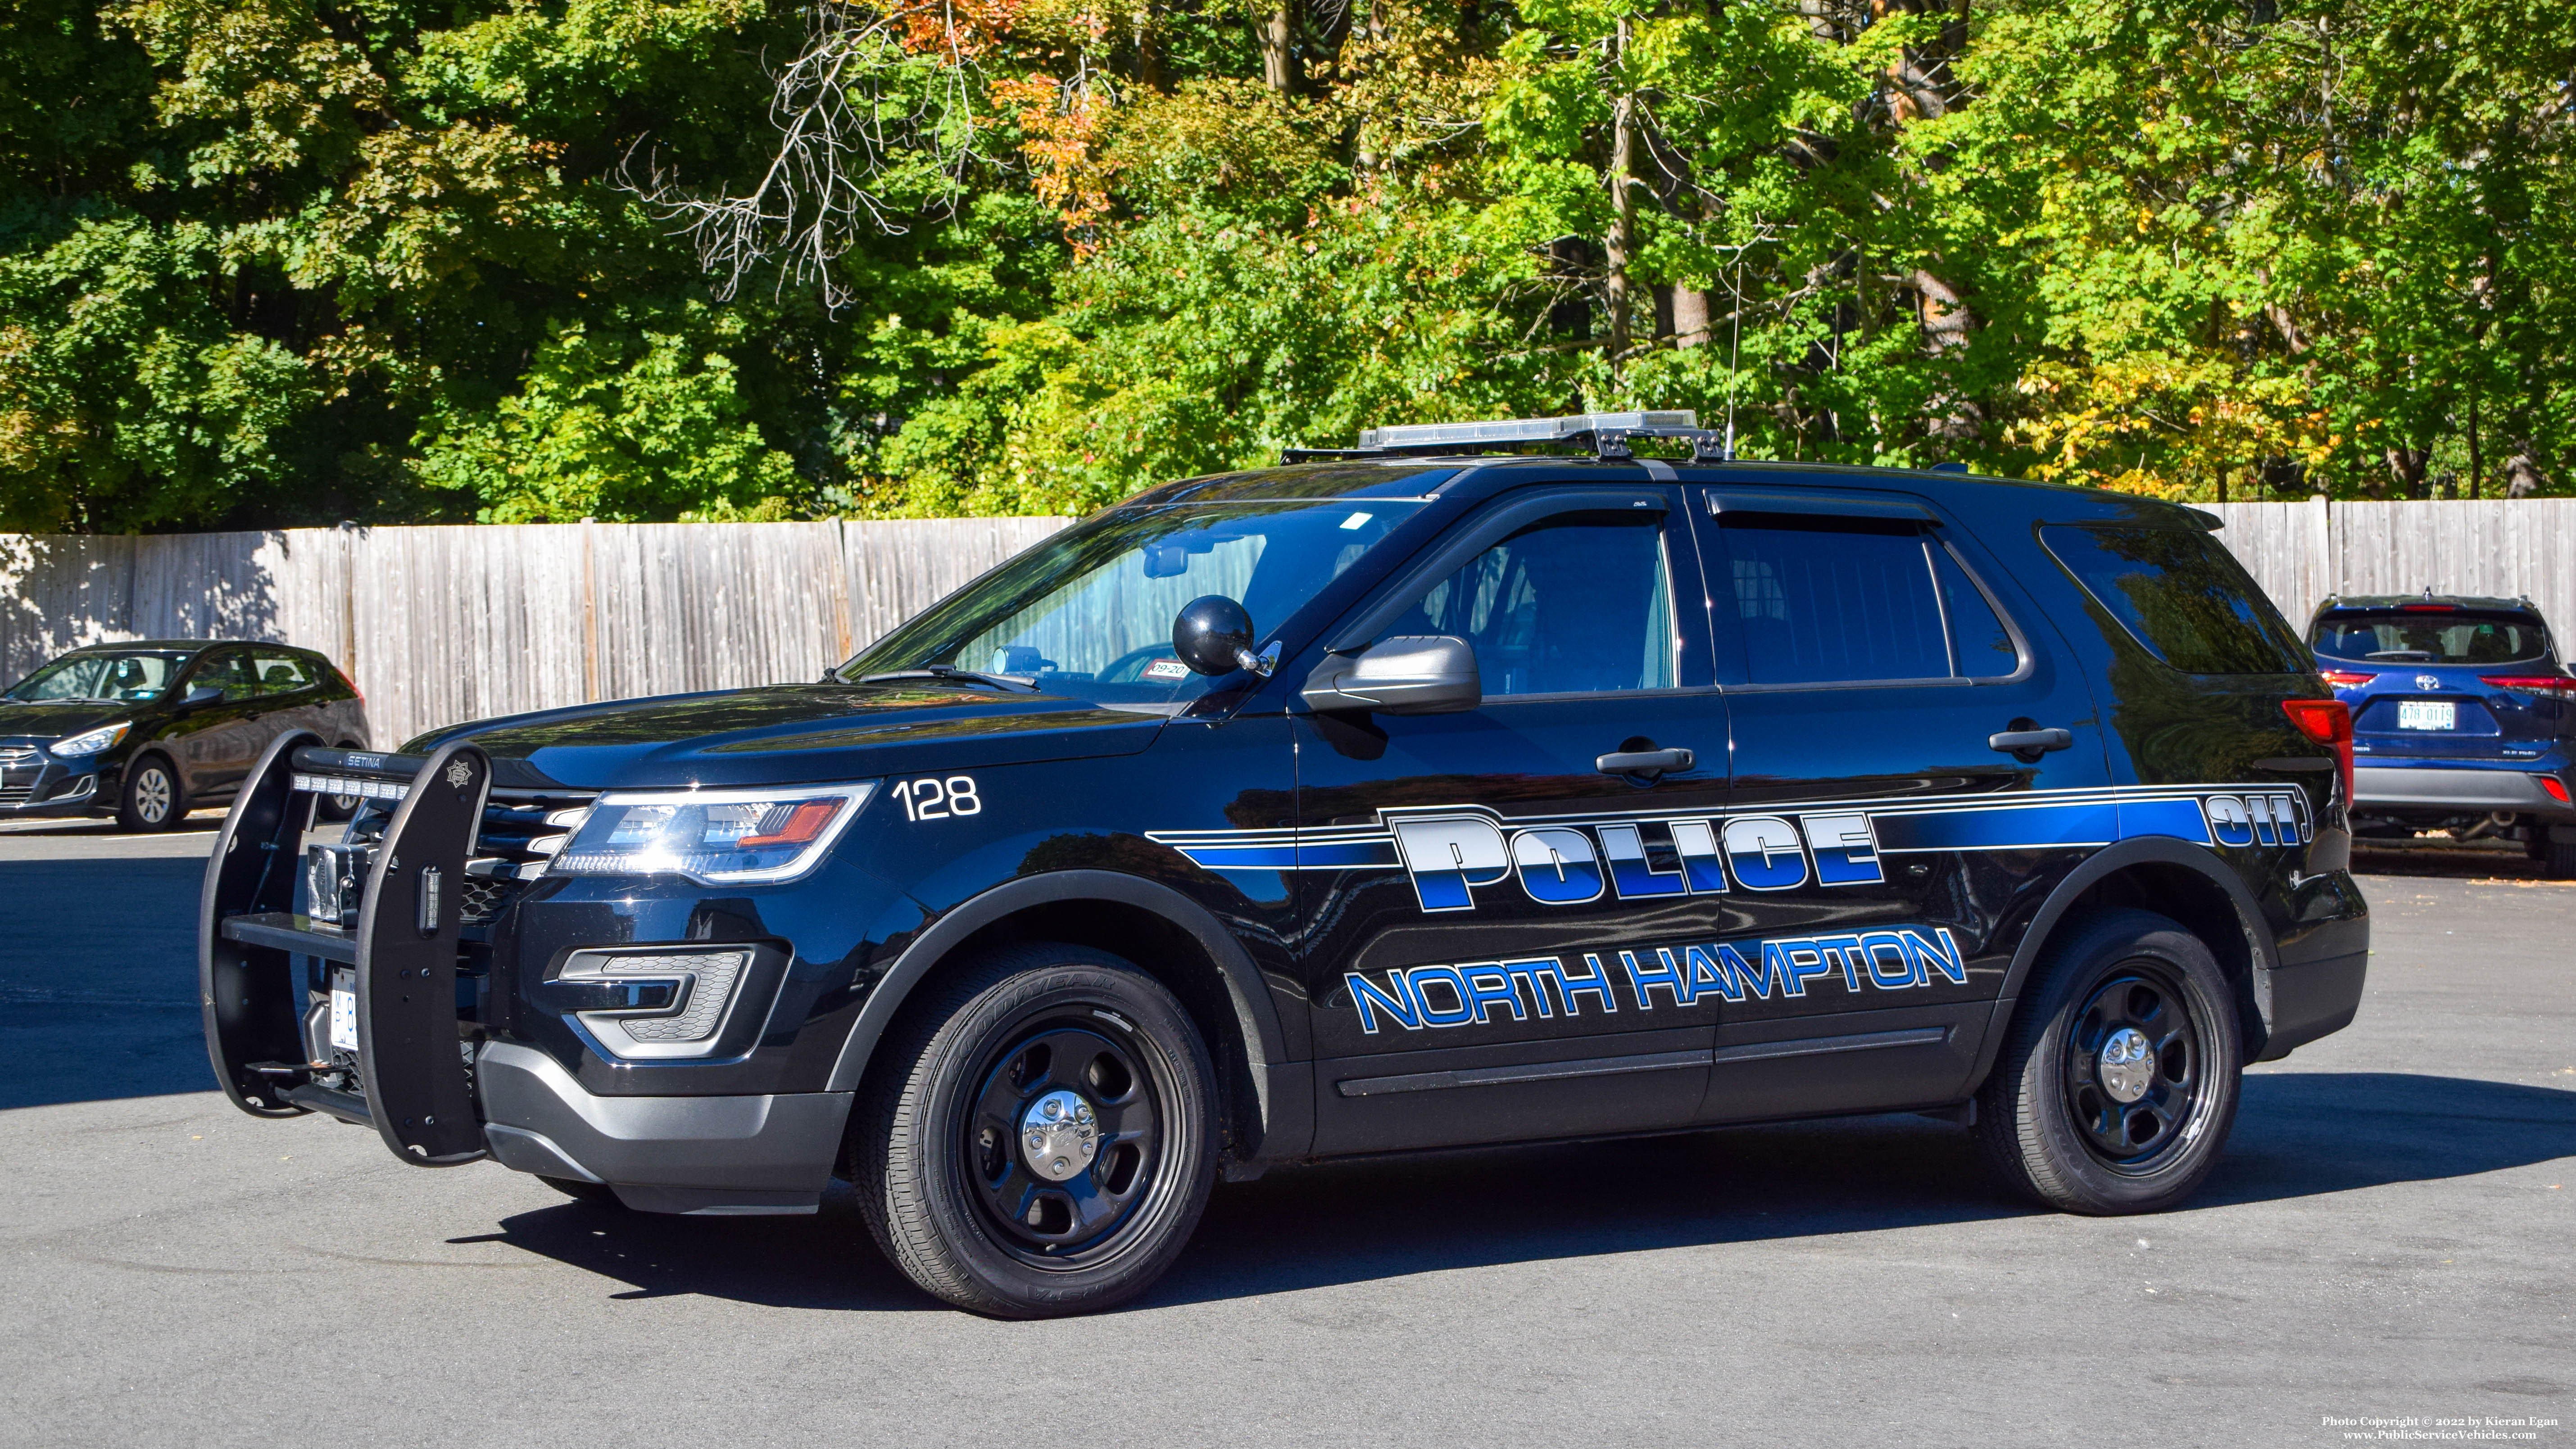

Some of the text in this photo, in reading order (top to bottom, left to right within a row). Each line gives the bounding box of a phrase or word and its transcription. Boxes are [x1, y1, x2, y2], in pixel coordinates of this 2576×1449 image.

[1152, 664, 1185, 674] 09-20
[2401, 707, 2452, 721] 478 0119
[348, 756, 380, 768] SETINA
[892, 776, 981, 822] 128
[2205, 795, 2299, 847] 911
[1389, 812, 1885, 913] POLICE
[1344, 928, 1968, 1034] NORTH HAMPTON
